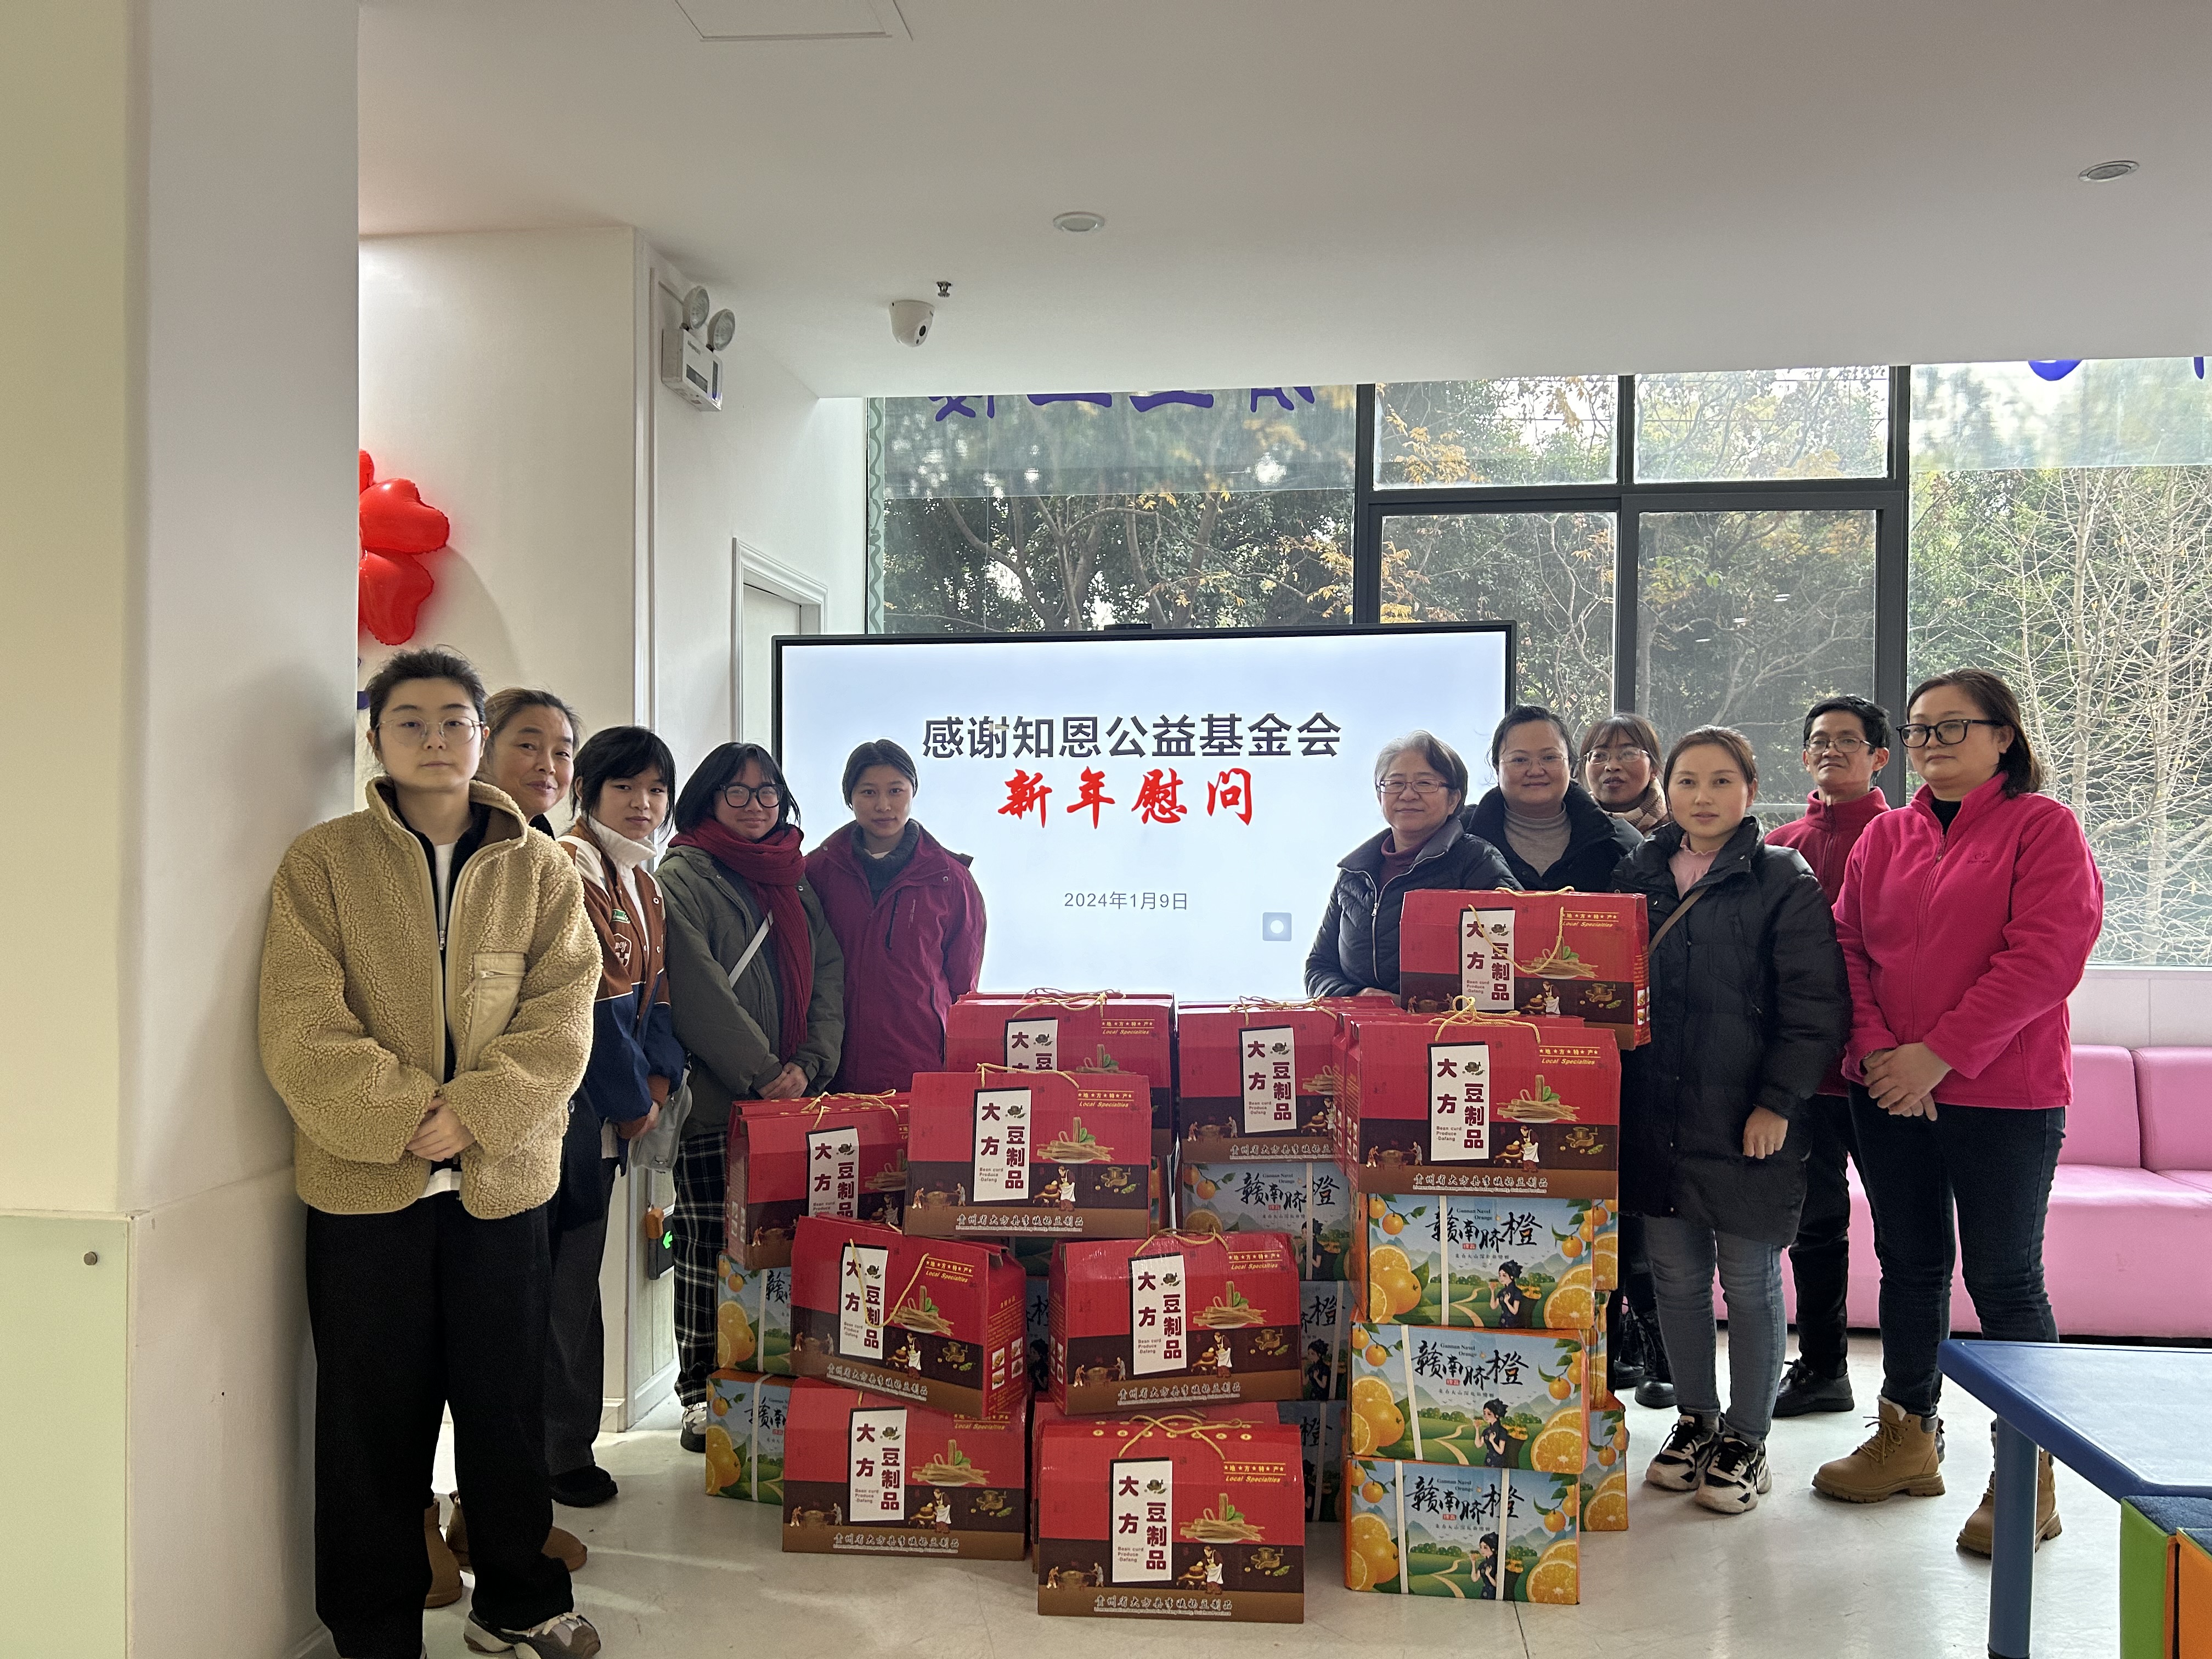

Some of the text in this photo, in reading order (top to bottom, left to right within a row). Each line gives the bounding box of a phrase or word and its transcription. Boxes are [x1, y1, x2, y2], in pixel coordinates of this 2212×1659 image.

[923, 712, 1341, 758] 感谢知恩公益基金会
[998, 766, 1253, 828] 新年慰问
[1064, 891, 1188, 910] 2024年1月9日
[1466, 921, 1485, 969] 大方
[1491, 943, 1509, 1000] 豆制品
[1036, 1053, 1052, 1070] 豆
[1248, 1041, 1266, 1090] 大方
[1437, 1058, 1457, 1114] 大方
[1273, 1062, 1291, 1120] 豆制品
[1464, 1083, 1484, 1148] 豆制品
[981, 1103, 1000, 1155] 大方
[814, 1143, 832, 1192] 大方
[1005, 1126, 1025, 1189] 豆制品
[837, 1162, 854, 1218] 豆制品
[845, 1259, 861, 1312] 大方
[1138, 1272, 1156, 1327] 大方
[864, 1285, 881, 1349] 豆制品
[1163, 1294, 1182, 1359] 豆制品
[856, 1424, 875, 1477] 大方
[881, 1448, 900, 1510] 豆制品
[1119, 1476, 1138, 1534] 大方
[1146, 1502, 1166, 1570] 豆制品
